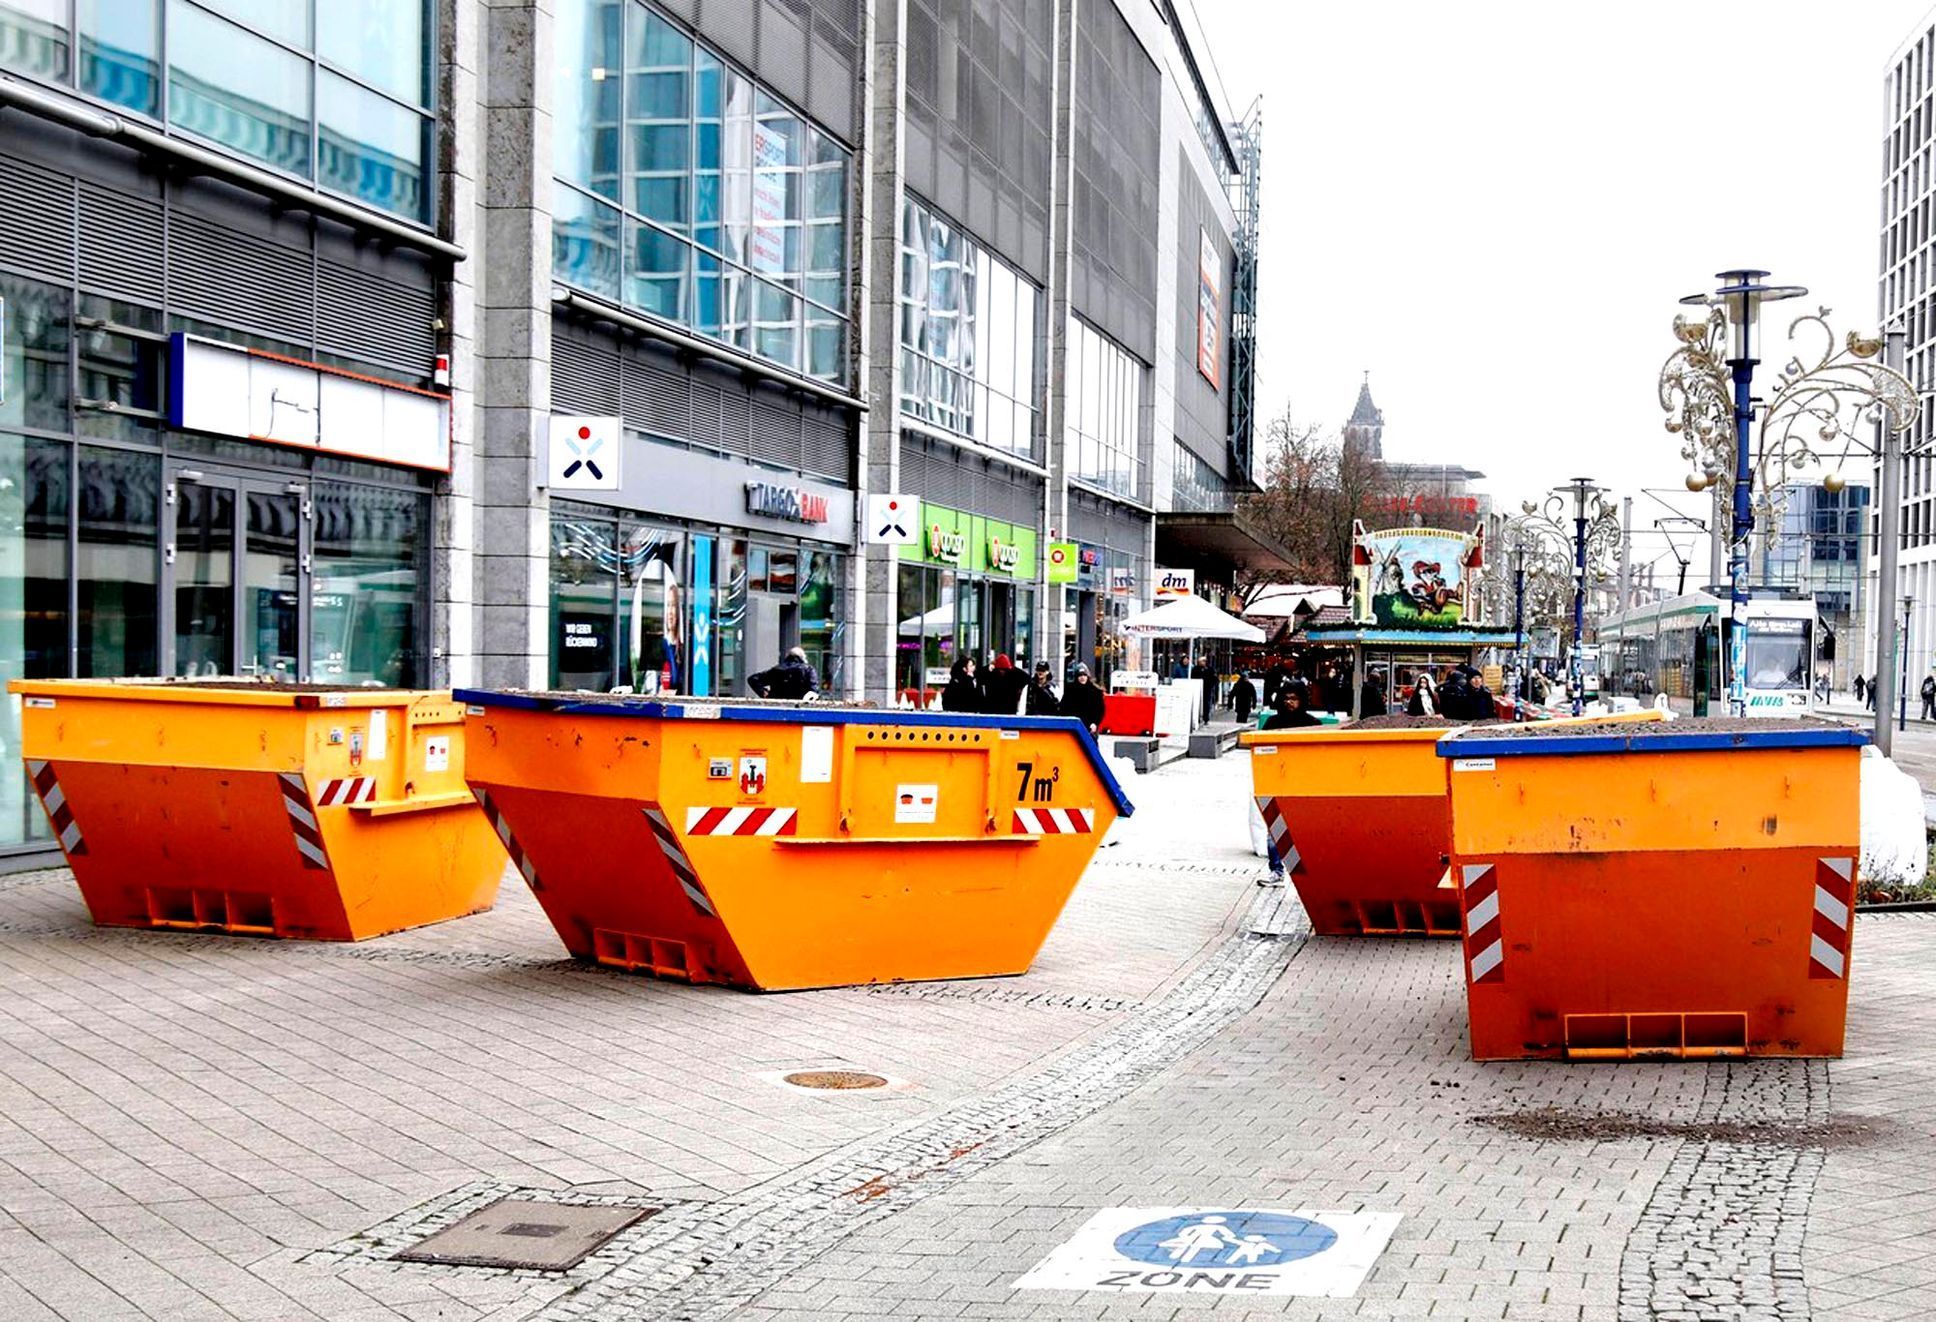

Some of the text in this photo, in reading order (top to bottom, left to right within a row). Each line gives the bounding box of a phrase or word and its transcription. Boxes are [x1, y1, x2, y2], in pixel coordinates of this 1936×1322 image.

[1161, 573, 1187, 588] dm
[1017, 762, 1033, 802] 7
[1096, 1270, 1281, 1290] ZONE
